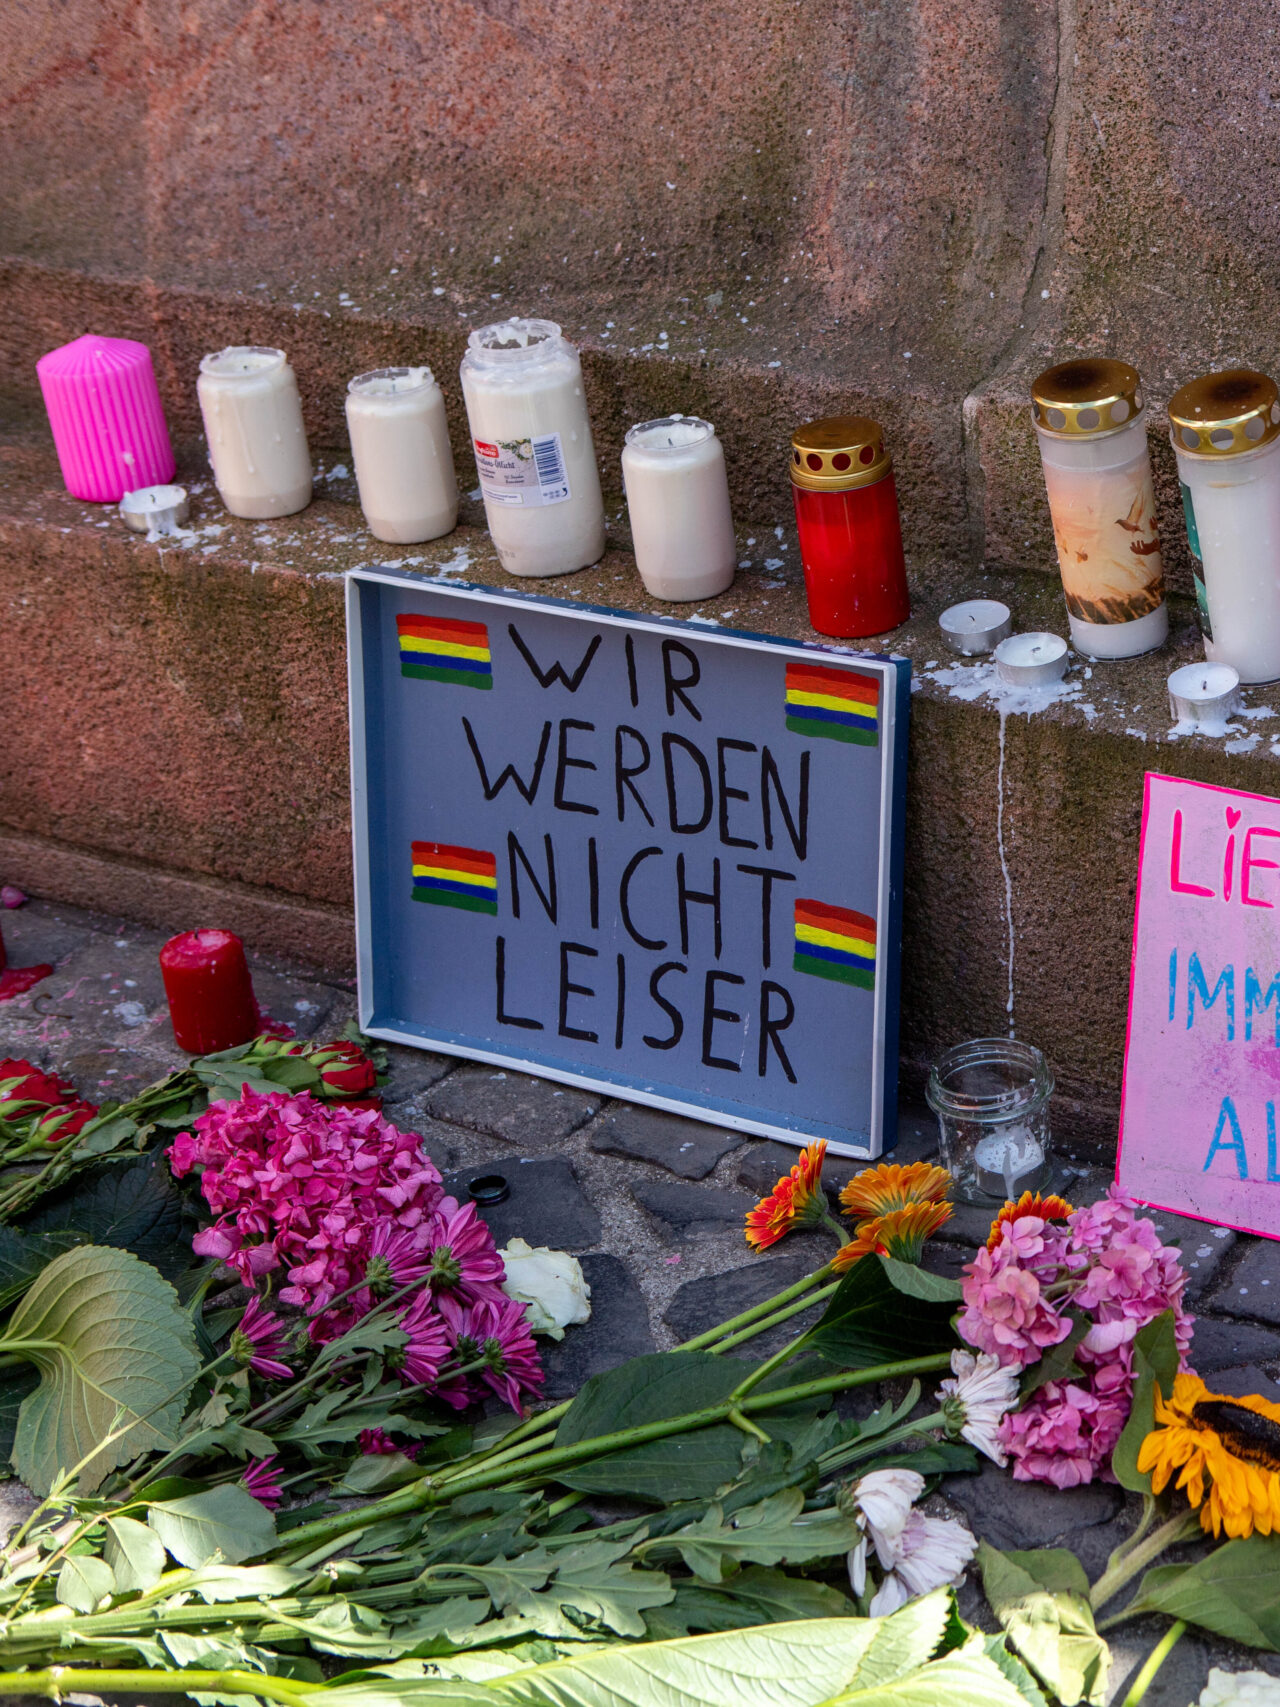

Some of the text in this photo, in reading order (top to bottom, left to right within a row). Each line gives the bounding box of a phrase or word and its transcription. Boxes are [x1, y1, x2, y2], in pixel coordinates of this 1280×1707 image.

[508, 622, 703, 722] WIR
[461, 715, 811, 861] WERDEN
[507, 830, 798, 970] NICHT
[495, 935, 798, 1085] LEISER
